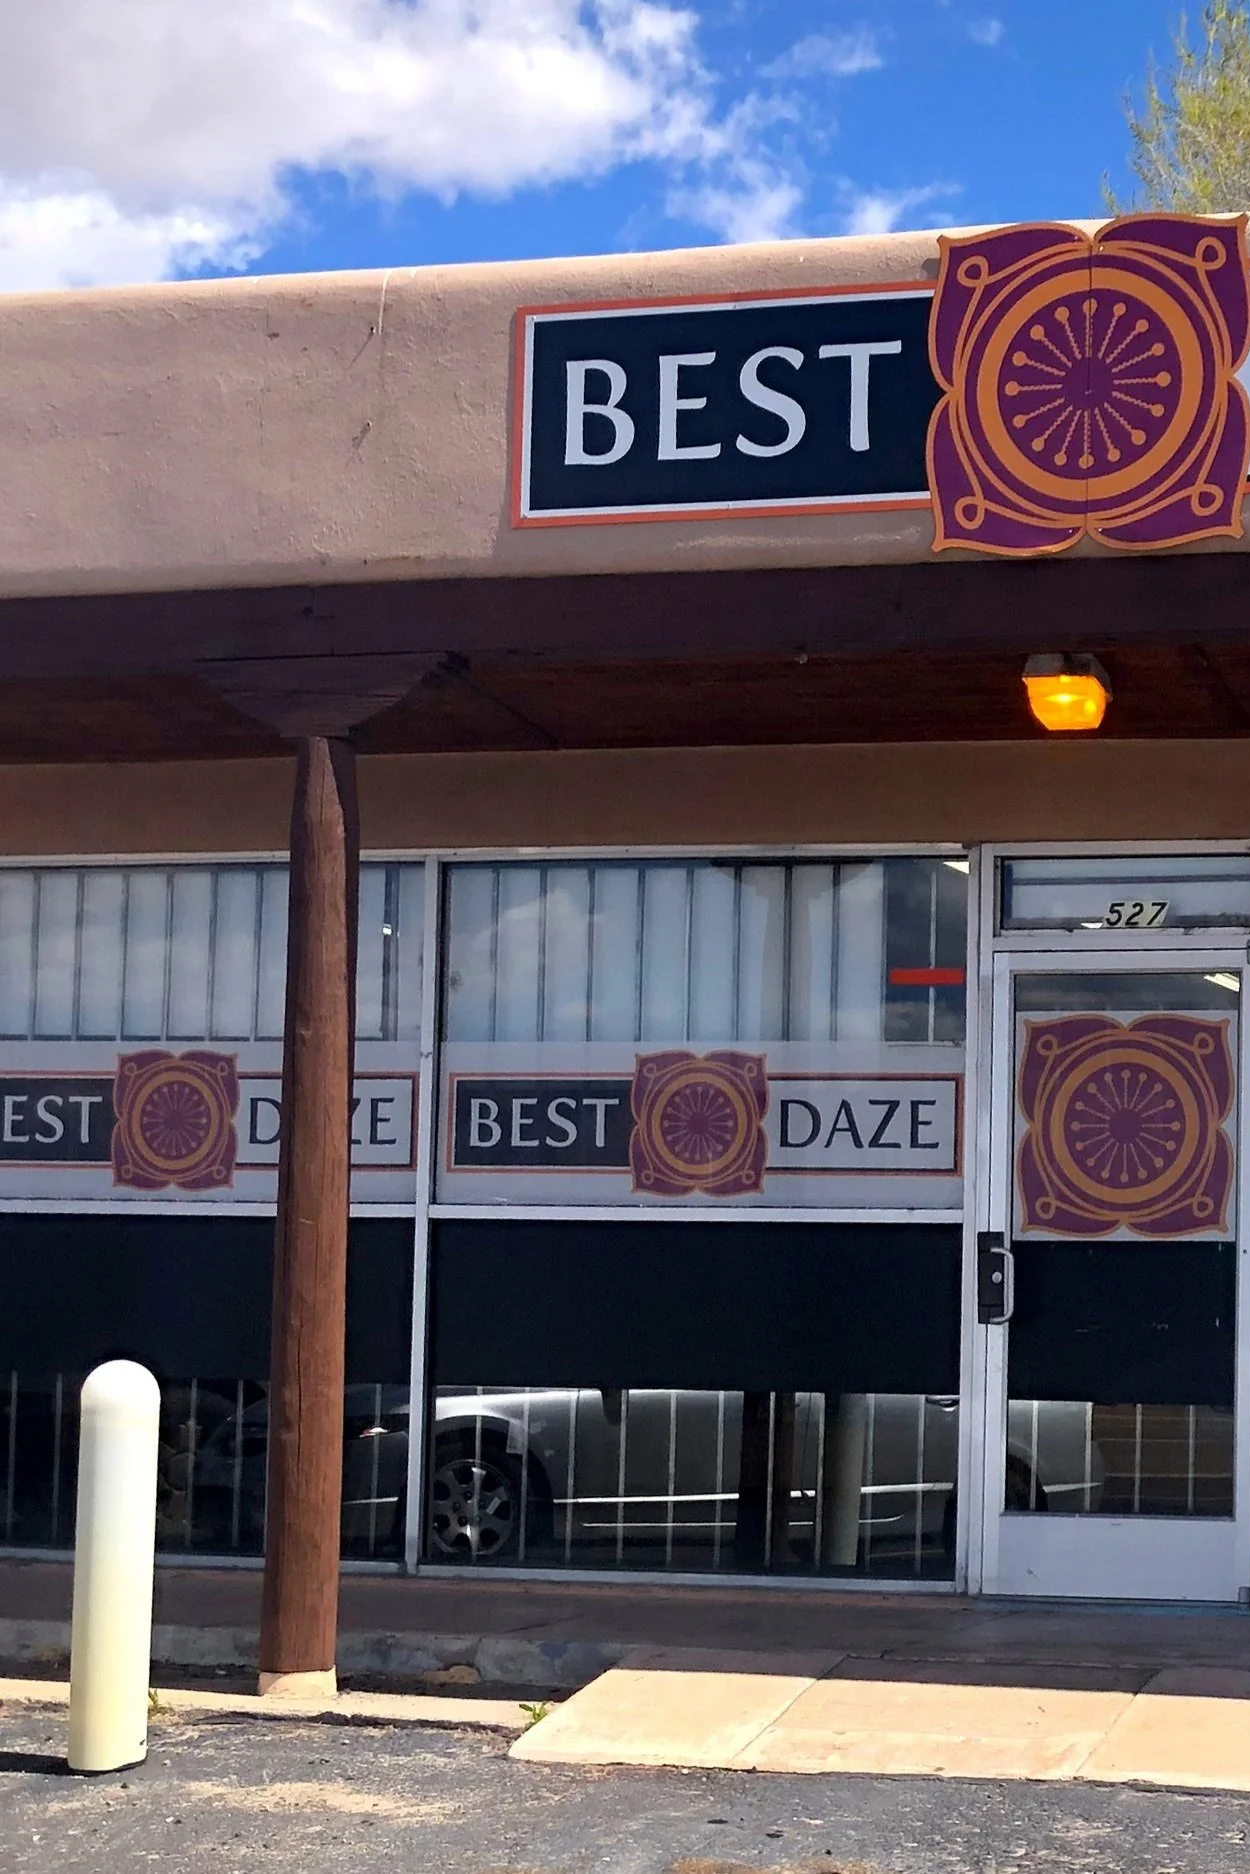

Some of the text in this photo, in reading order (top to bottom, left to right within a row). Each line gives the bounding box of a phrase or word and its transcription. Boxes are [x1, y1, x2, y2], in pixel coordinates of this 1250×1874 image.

[564, 339, 902, 465] BEST
[1105, 902, 1168, 926] 527
[3, 1094, 397, 1145] EST DE
[470, 1097, 940, 1149] BEST DAZE
